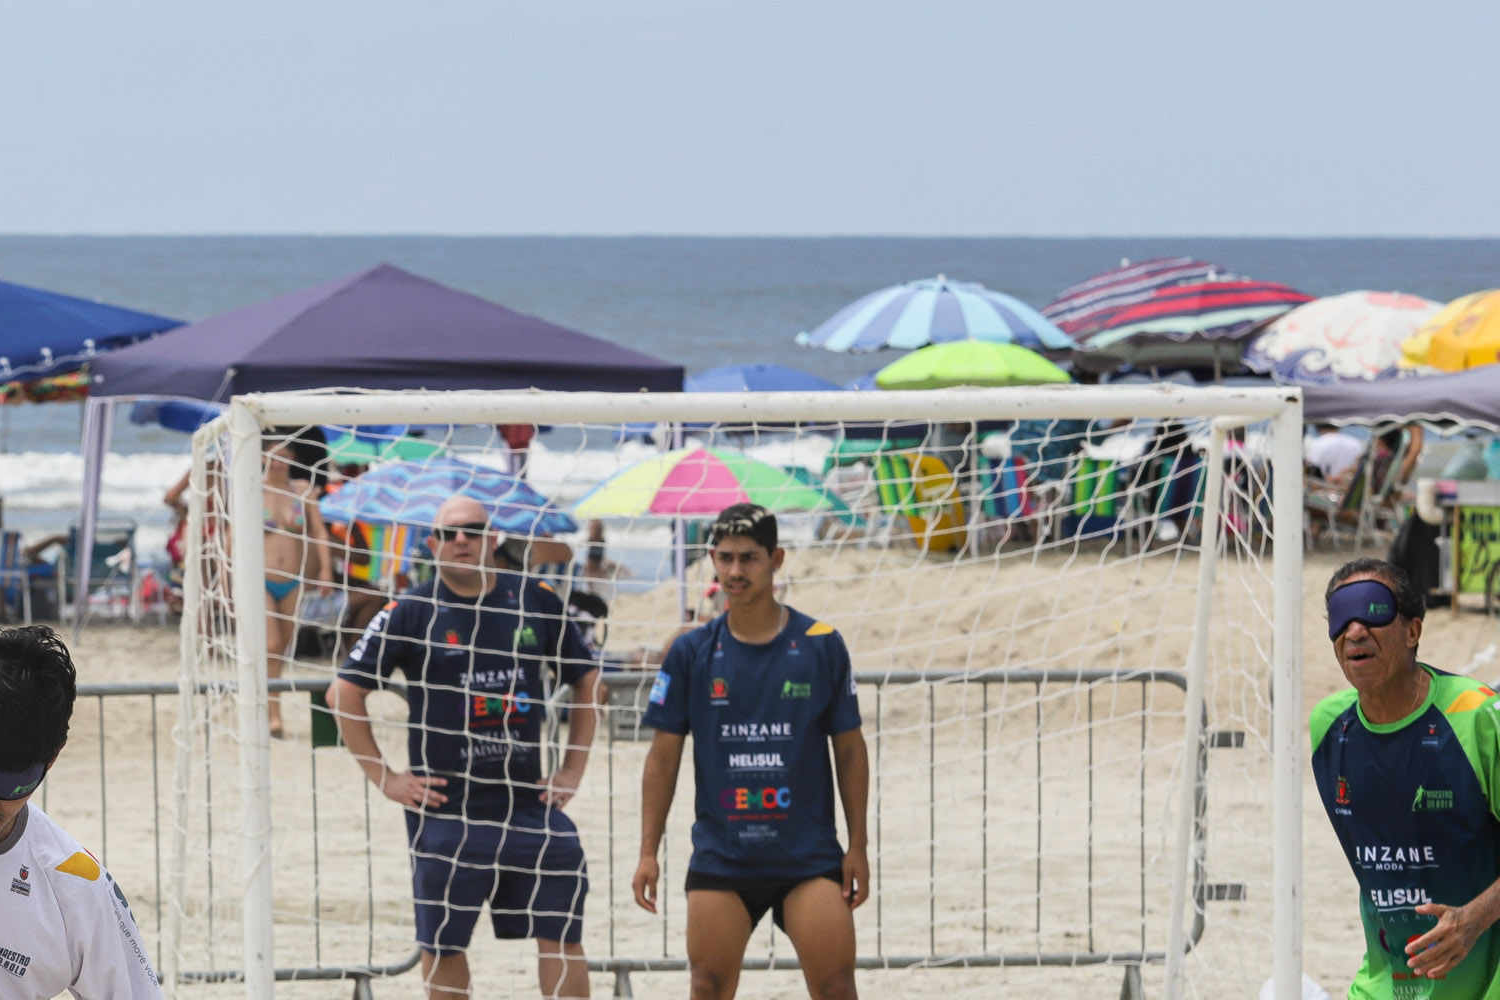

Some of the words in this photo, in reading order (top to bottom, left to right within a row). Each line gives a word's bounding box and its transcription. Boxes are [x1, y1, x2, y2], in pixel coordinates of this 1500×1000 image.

[721, 723, 792, 737] ZINZANE
[729, 753, 785, 767] HELISUL
[719, 787, 791, 810] CEMOC
[1375, 863, 1404, 871] MODA
